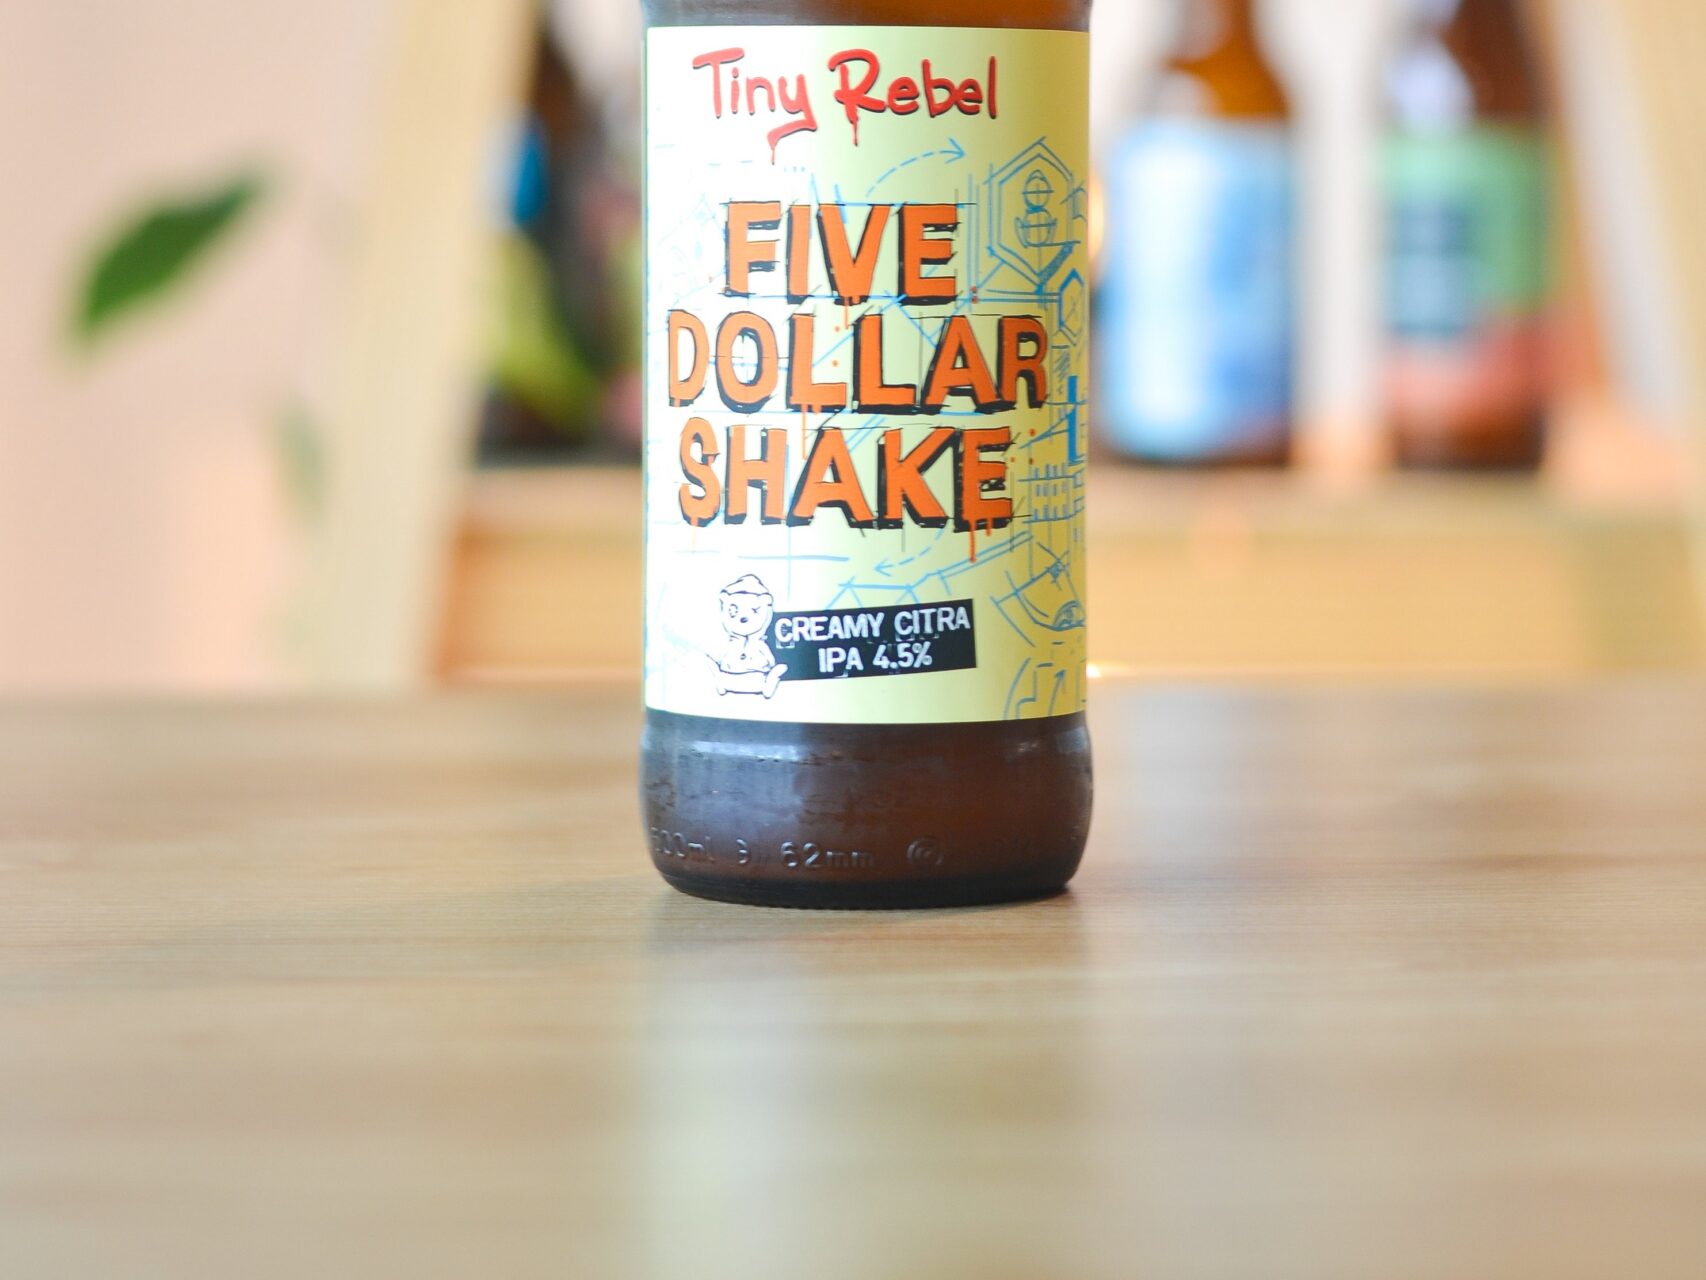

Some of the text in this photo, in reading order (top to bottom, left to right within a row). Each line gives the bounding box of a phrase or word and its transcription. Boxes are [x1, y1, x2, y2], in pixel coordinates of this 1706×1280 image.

[692, 47, 998, 152] Tiny Rebel
[722, 200, 962, 304] FIVE
[668, 309, 1049, 414] DOLLAR
[678, 417, 1015, 532] SHAKE
[774, 606, 972, 643] CREAMY CITRA
[818, 641, 933, 673] IPA 4.5%
[780, 840, 876, 870] 62mm
